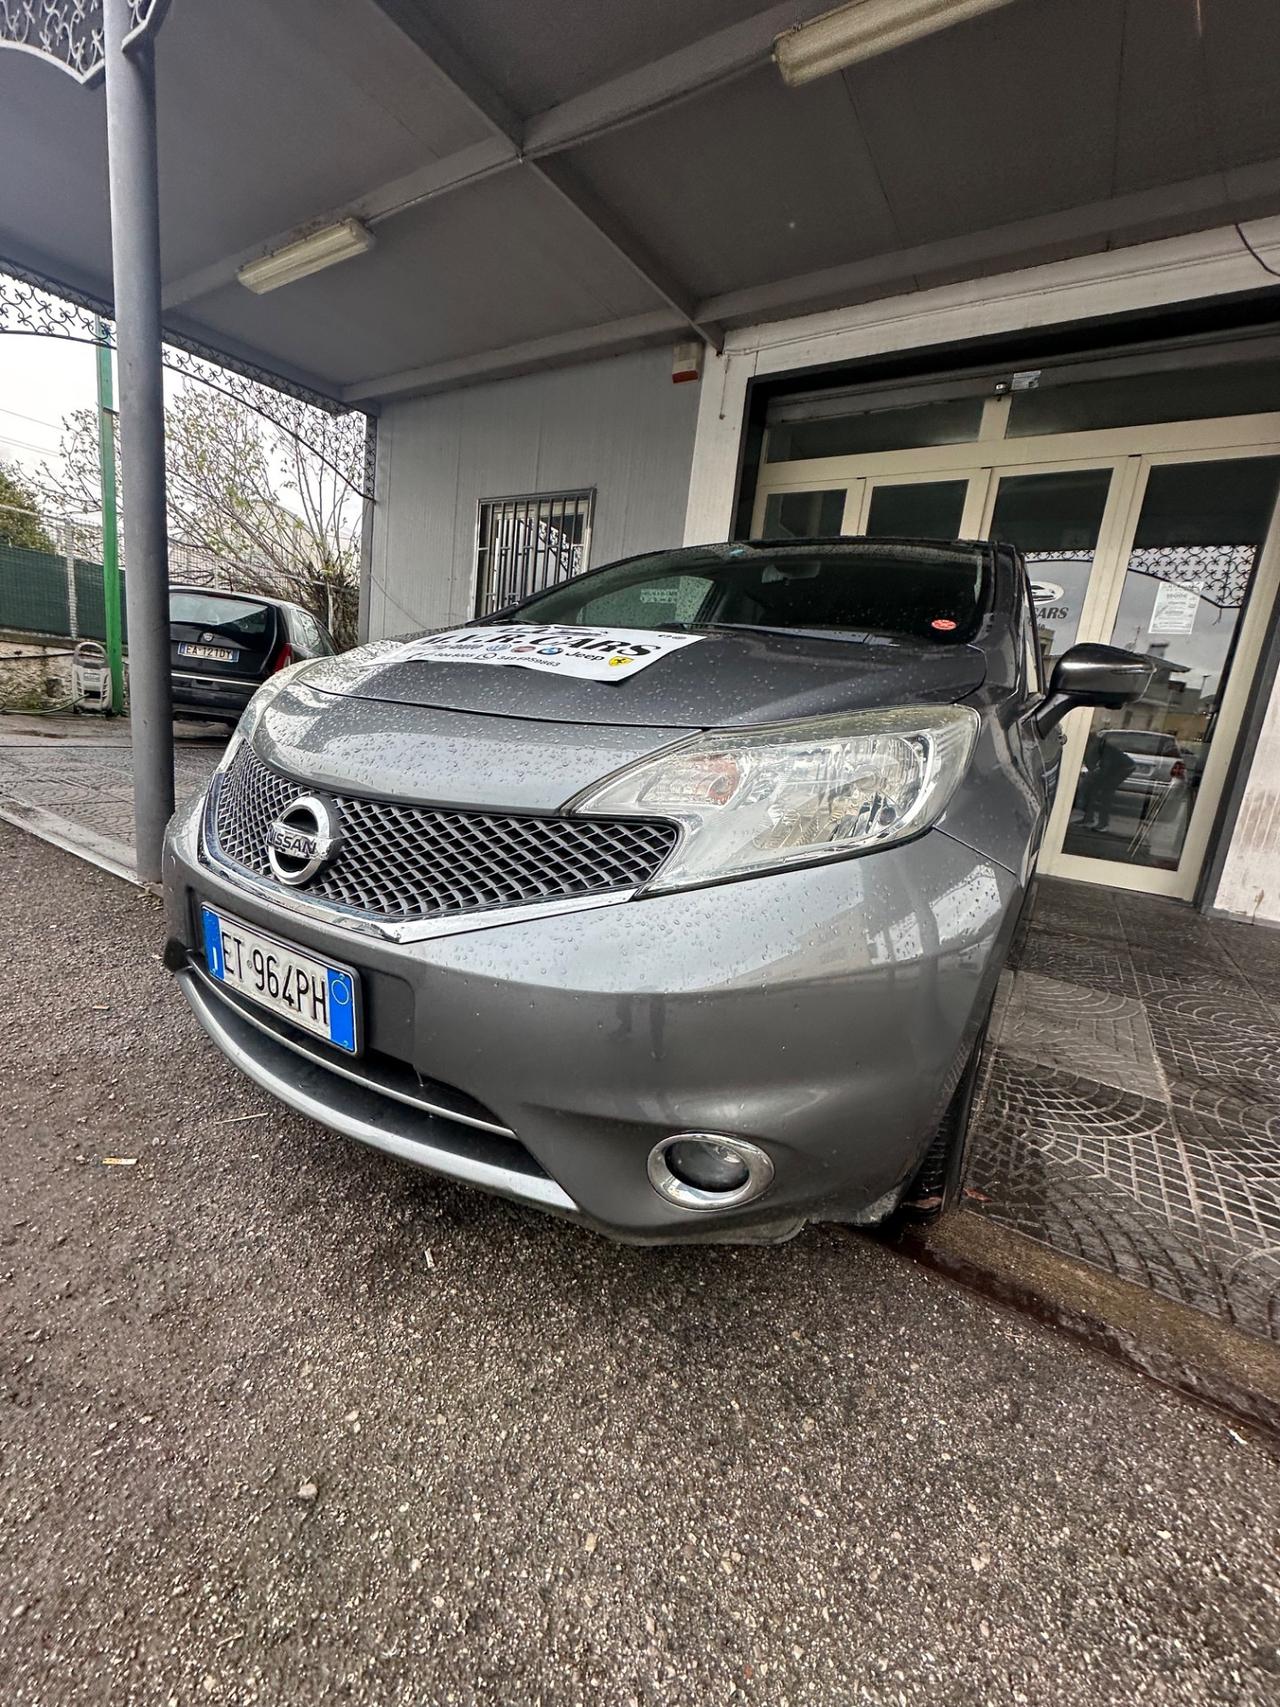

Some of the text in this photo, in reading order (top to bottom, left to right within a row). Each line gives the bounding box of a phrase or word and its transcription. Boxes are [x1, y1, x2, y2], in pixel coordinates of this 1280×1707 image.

[529, 635, 662, 656] CARS
[565, 651, 605, 661] Jeep
[267, 828, 317, 856] NISSAN
[222, 931, 243, 980] ET
[252, 949, 328, 1025] 964PH
